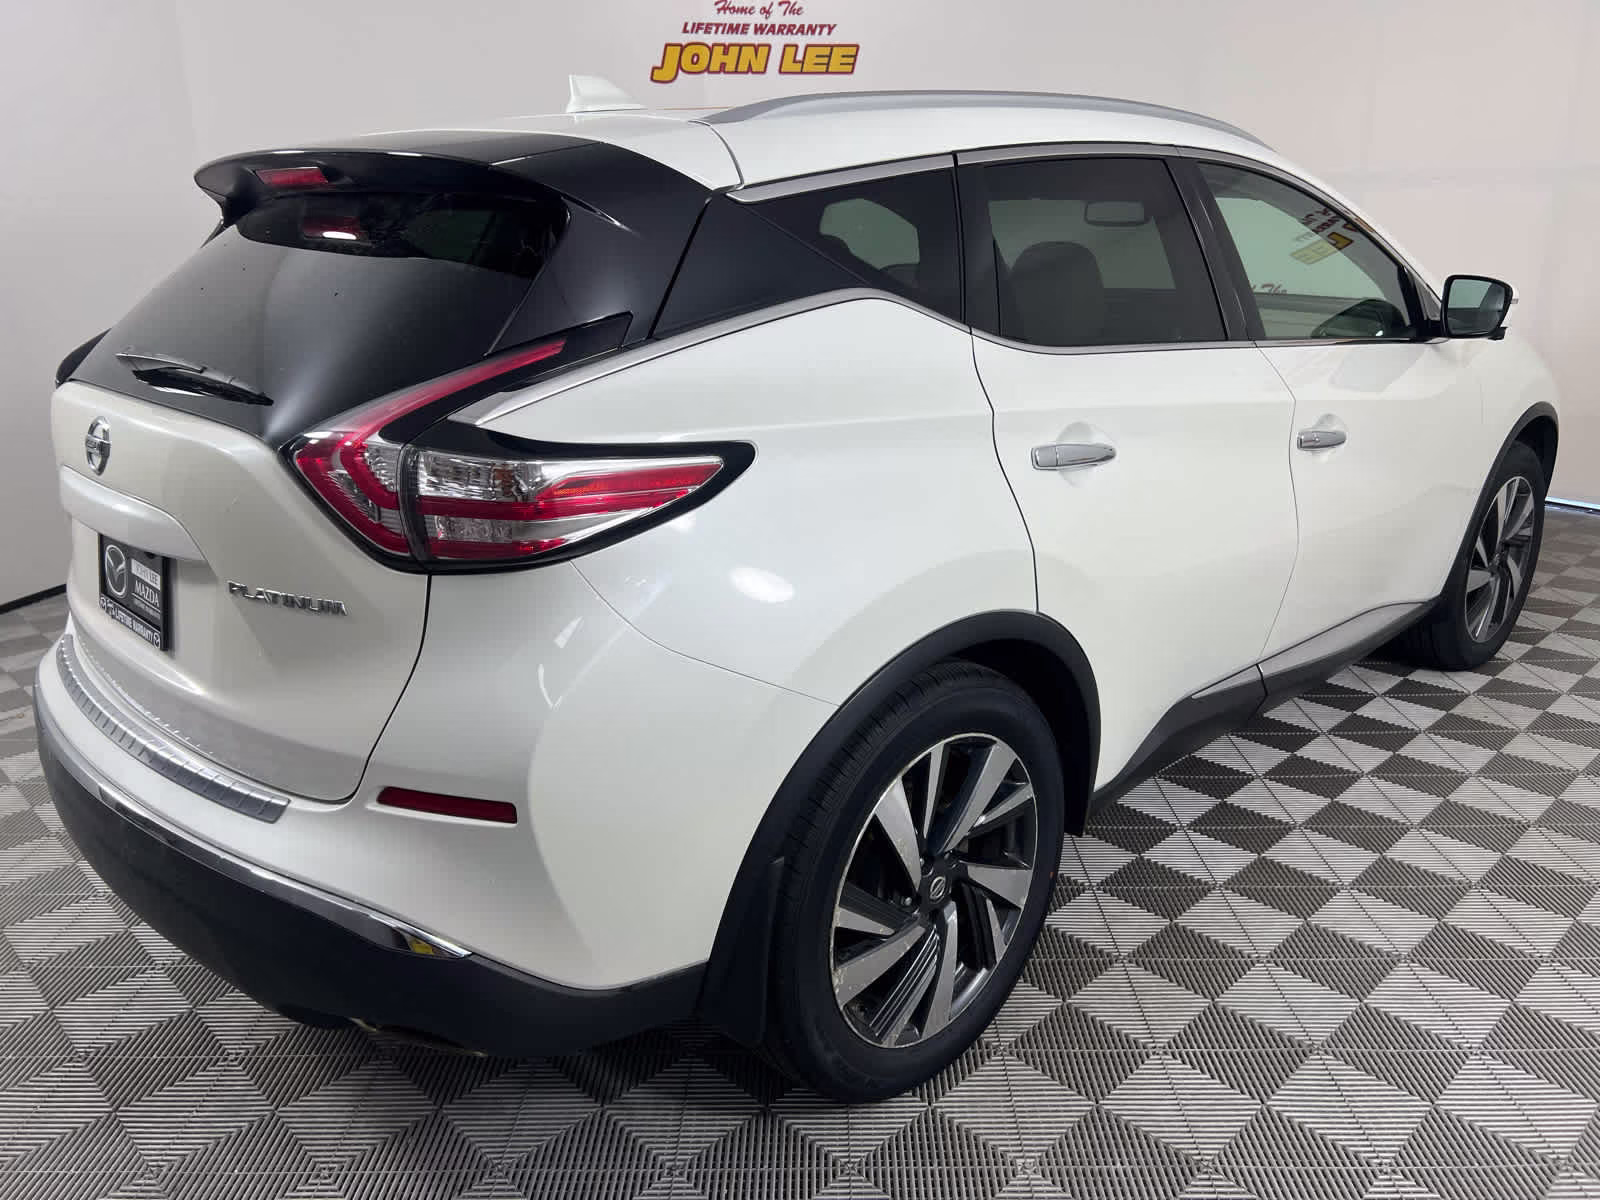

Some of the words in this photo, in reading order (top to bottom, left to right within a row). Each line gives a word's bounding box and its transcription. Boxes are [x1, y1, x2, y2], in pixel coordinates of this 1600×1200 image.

[714, 0, 756, 16] Home
[760, 2, 772, 19] of
[778, 1, 804, 16] The
[681, 22, 751, 35] LIFETIME
[753, 23, 837, 36] WARRANTY
[650, 42, 772, 84] JOHN
[779, 44, 860, 75] LEE
[134, 580, 160, 608] MAZDA
[227, 580, 348, 616] PLATINUM
